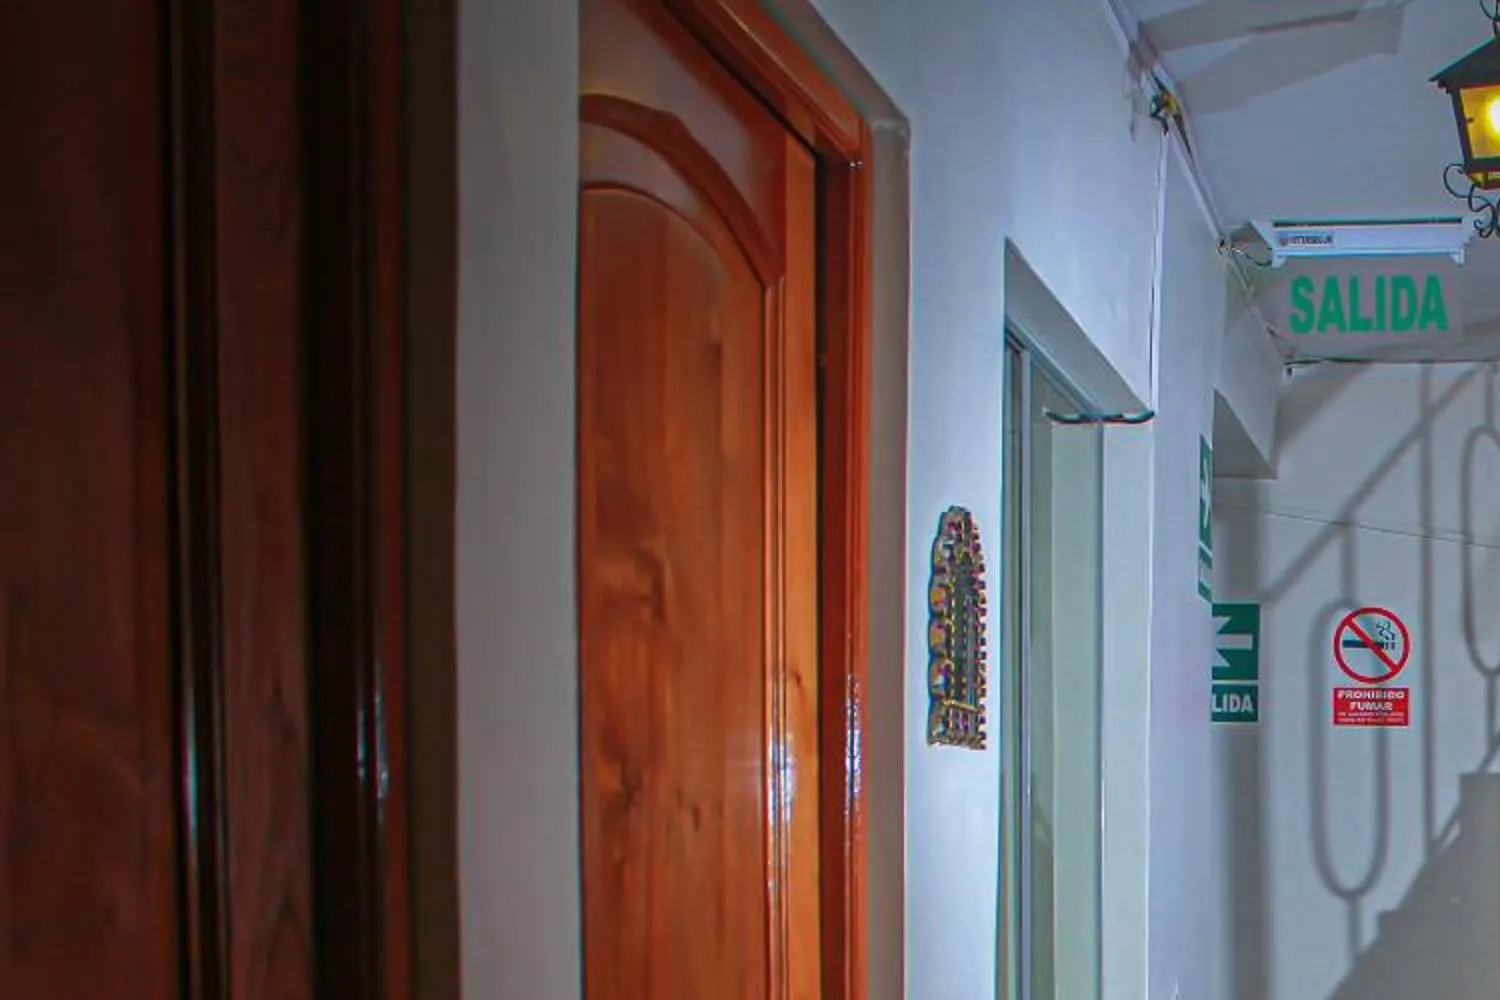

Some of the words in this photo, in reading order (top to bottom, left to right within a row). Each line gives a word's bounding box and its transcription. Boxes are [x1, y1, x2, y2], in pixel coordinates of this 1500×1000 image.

[1289, 275, 1448, 333] SALIDA
[1211, 692, 1254, 713] LIDA
[1336, 689, 1405, 700] PROHIBIDO
[1349, 700, 1393, 711] FUMAR
